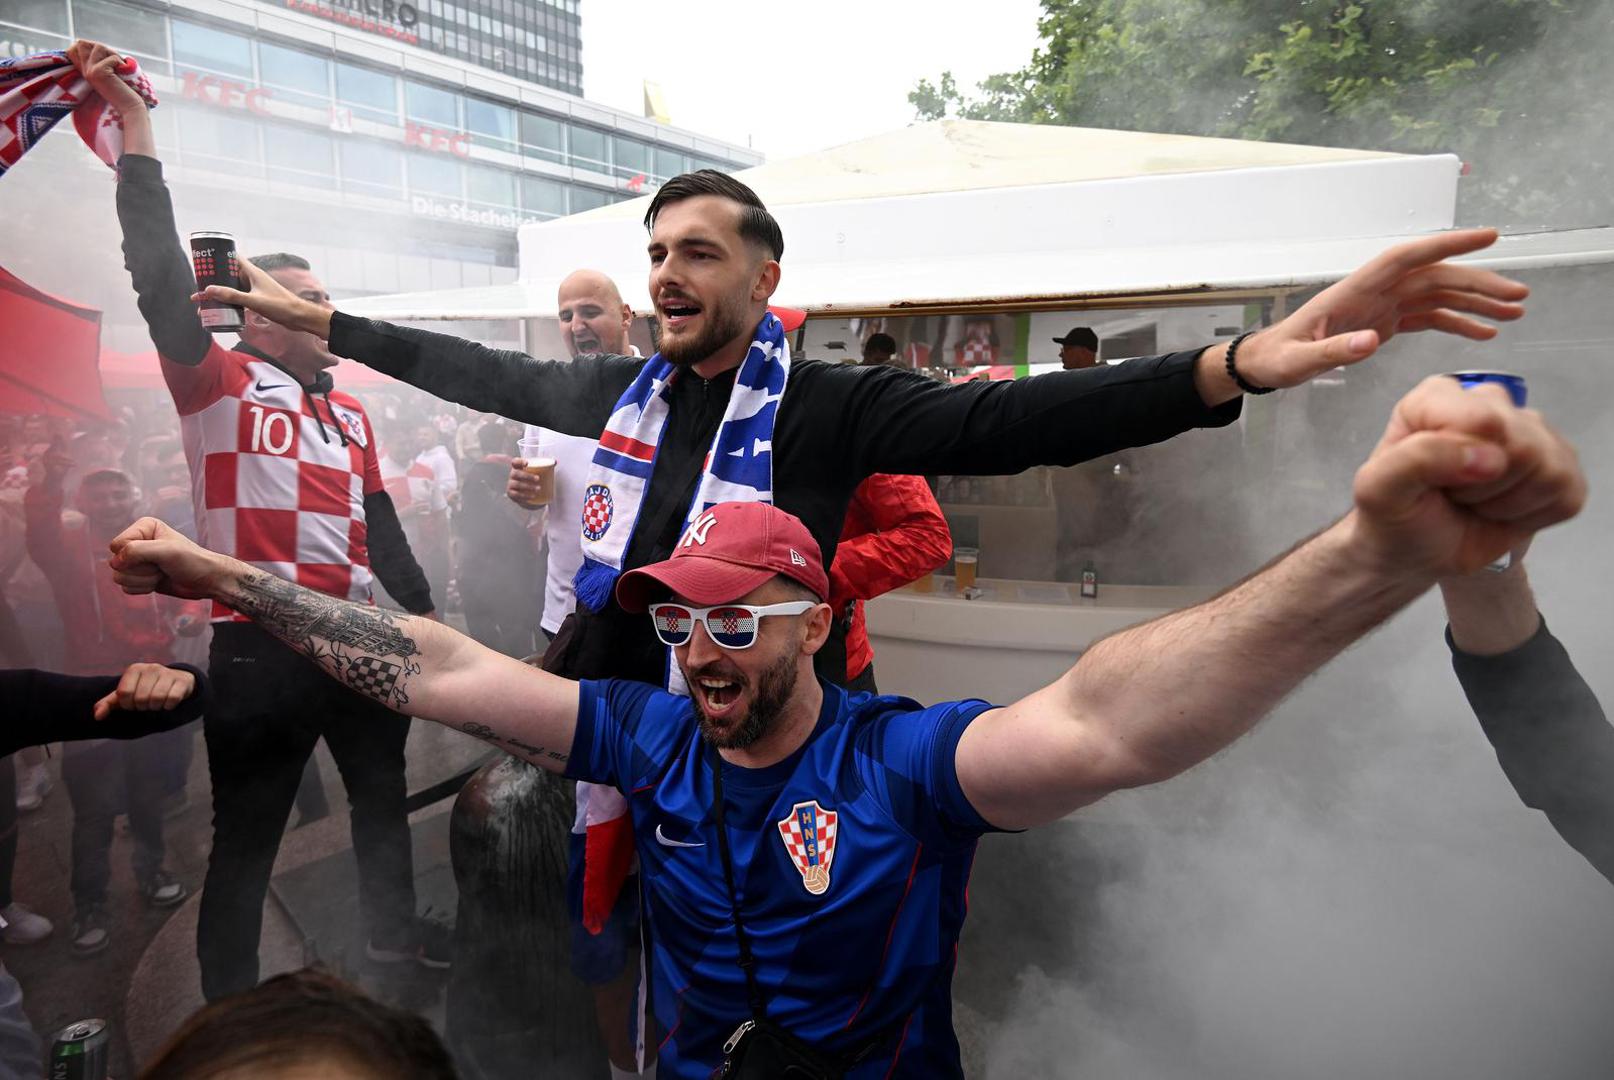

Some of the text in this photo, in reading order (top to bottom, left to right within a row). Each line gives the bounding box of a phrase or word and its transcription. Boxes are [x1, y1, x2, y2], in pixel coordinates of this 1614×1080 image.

[182, 71, 273, 117] KFC
[404, 121, 472, 160] KFC
[412, 195, 448, 217] Die
[248, 406, 294, 455] 10
[678, 512, 718, 548] NY
[802, 812, 816, 857] HNS
